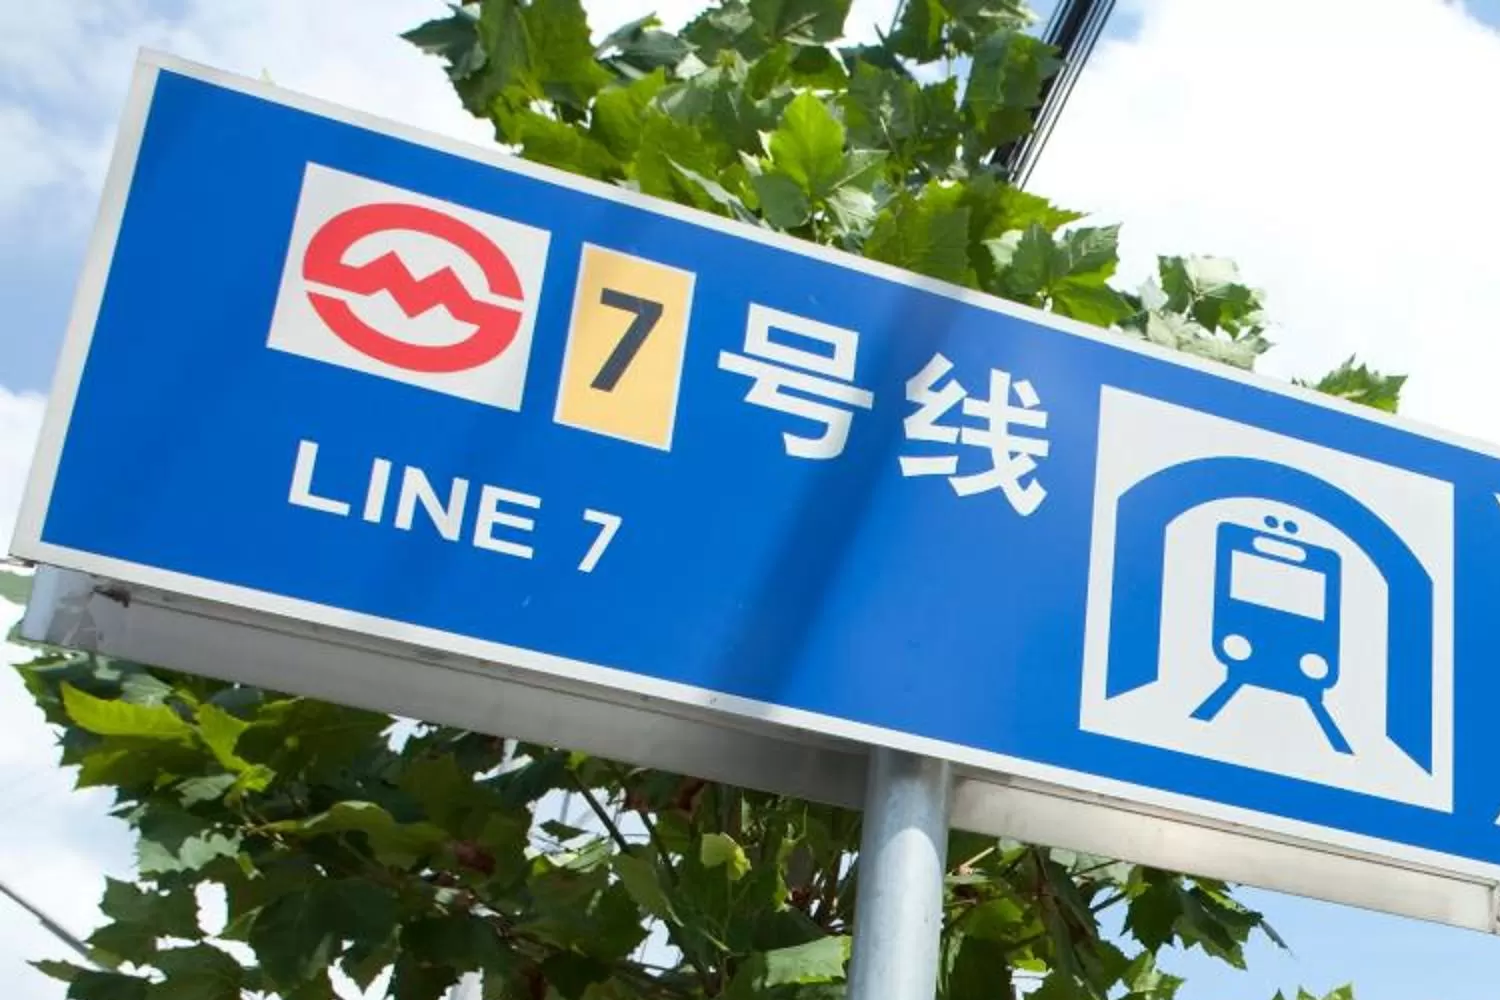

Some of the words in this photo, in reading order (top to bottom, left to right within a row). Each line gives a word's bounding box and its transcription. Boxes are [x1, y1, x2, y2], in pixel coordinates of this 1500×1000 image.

[590, 288, 665, 392] 7
[718, 303, 1049, 516] 号线
[288, 440, 541, 559] LINE
[579, 509, 622, 573] 7
